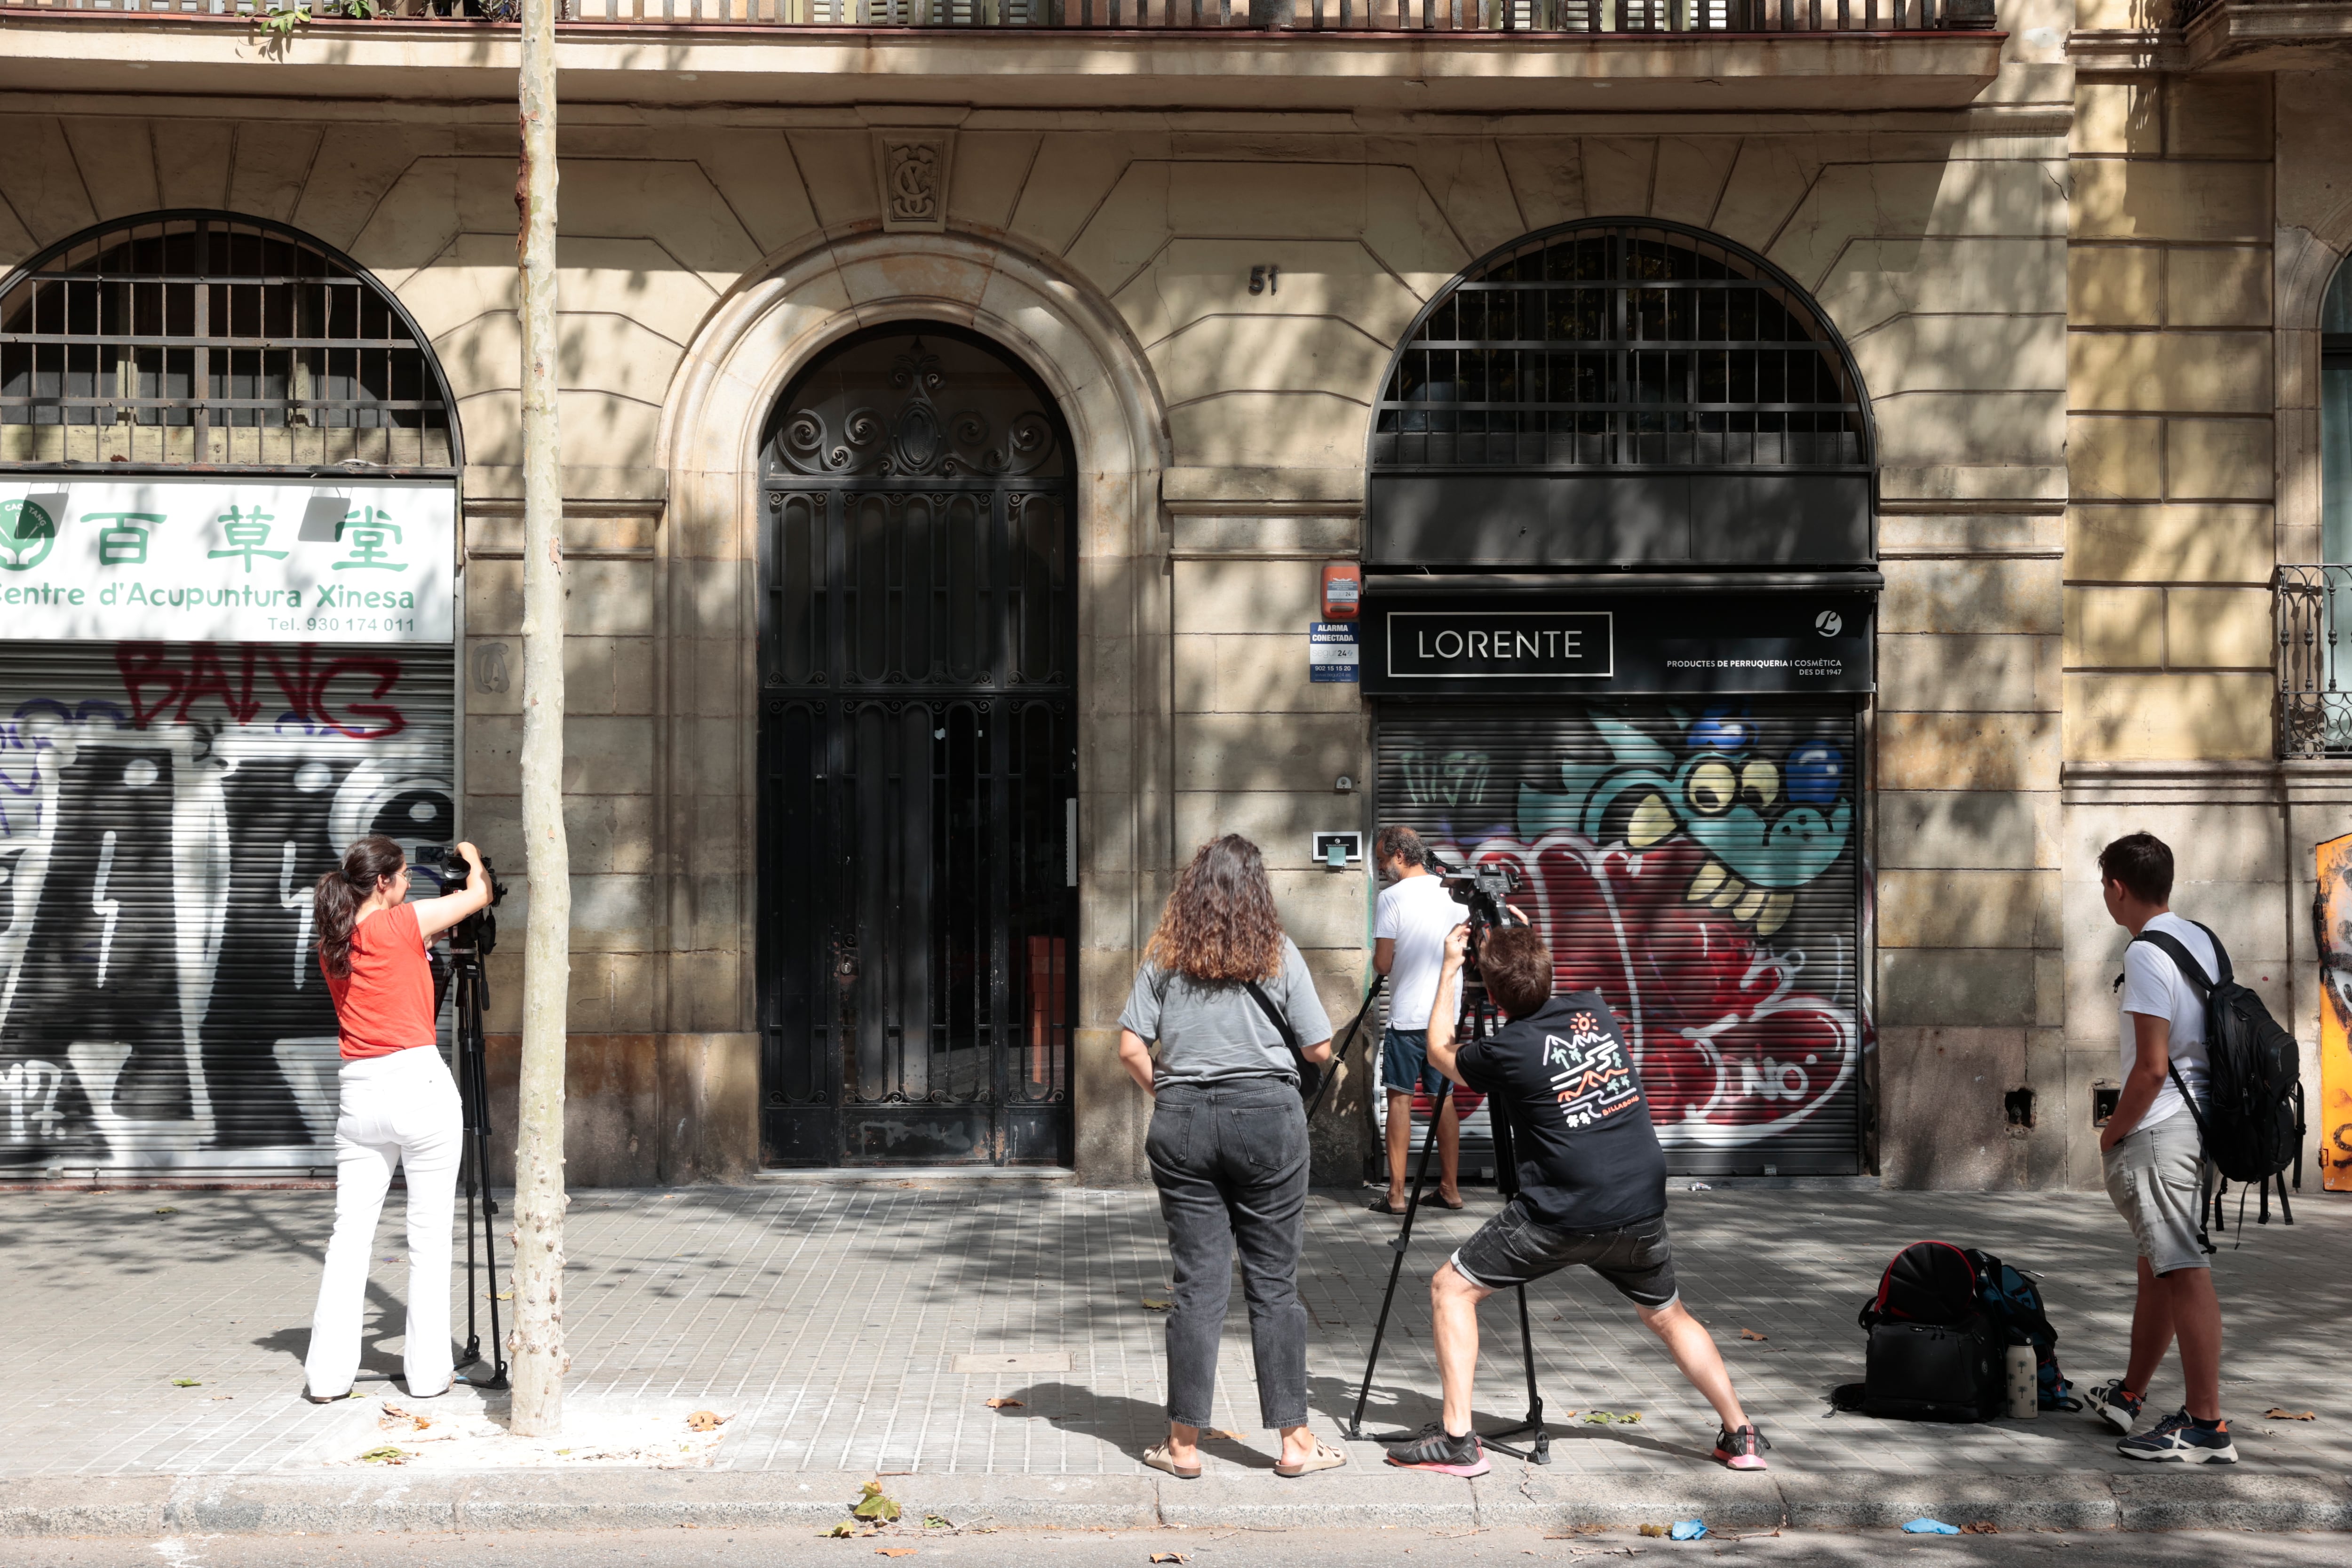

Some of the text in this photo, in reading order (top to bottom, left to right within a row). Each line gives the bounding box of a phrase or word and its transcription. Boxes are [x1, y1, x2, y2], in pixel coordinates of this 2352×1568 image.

[1248, 266, 1277, 295] 51
[28, 506, 46, 526] TANG
[80, 505, 408, 573] 百草堂
[0, 582, 414, 611] entre d'Acupuntura Xinesa
[268, 617, 414, 632] Tel. 930 174 011
[1312, 649, 1347, 658] segur24
[1419, 630, 1582, 658] LORENTE
[1730, 660, 1788, 668] PERRUQUERIA
[1795, 658, 1842, 667] COSMÈTICA
[117, 642, 408, 739] BANG
[1602, 1095, 1639, 1116] BILLABONG
